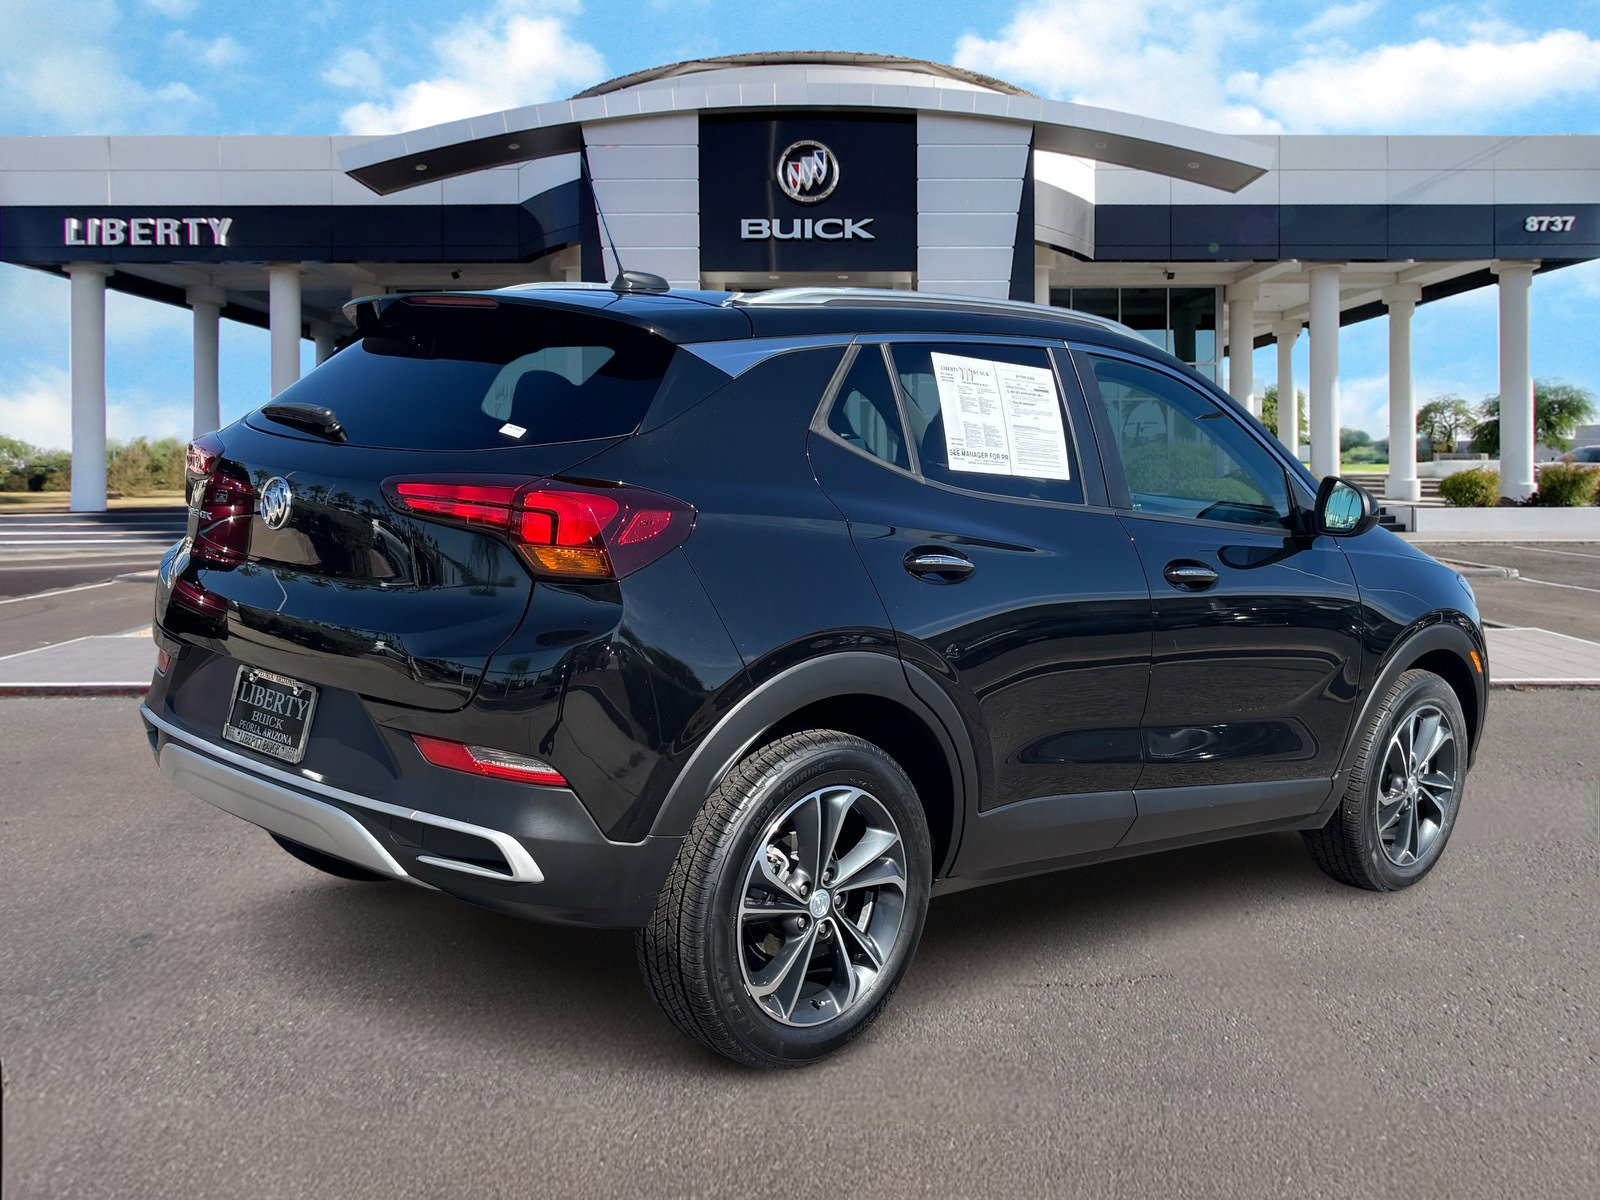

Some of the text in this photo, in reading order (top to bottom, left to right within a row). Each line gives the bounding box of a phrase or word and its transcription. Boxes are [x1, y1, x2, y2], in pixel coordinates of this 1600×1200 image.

[64, 217, 233, 246] LIBERTY
[740, 218, 876, 240] BUICK
[1524, 215, 1576, 232] 8737
[949, 449, 961, 457] SEE
[961, 450, 988, 459] MANAGER
[989, 452, 1001, 460] FOR
[239, 681, 309, 721] LIBERTY
[251, 710, 285, 731] BUICK
[262, 727, 293, 746] ARIZONA
[779, 762, 825, 796] TOURING
